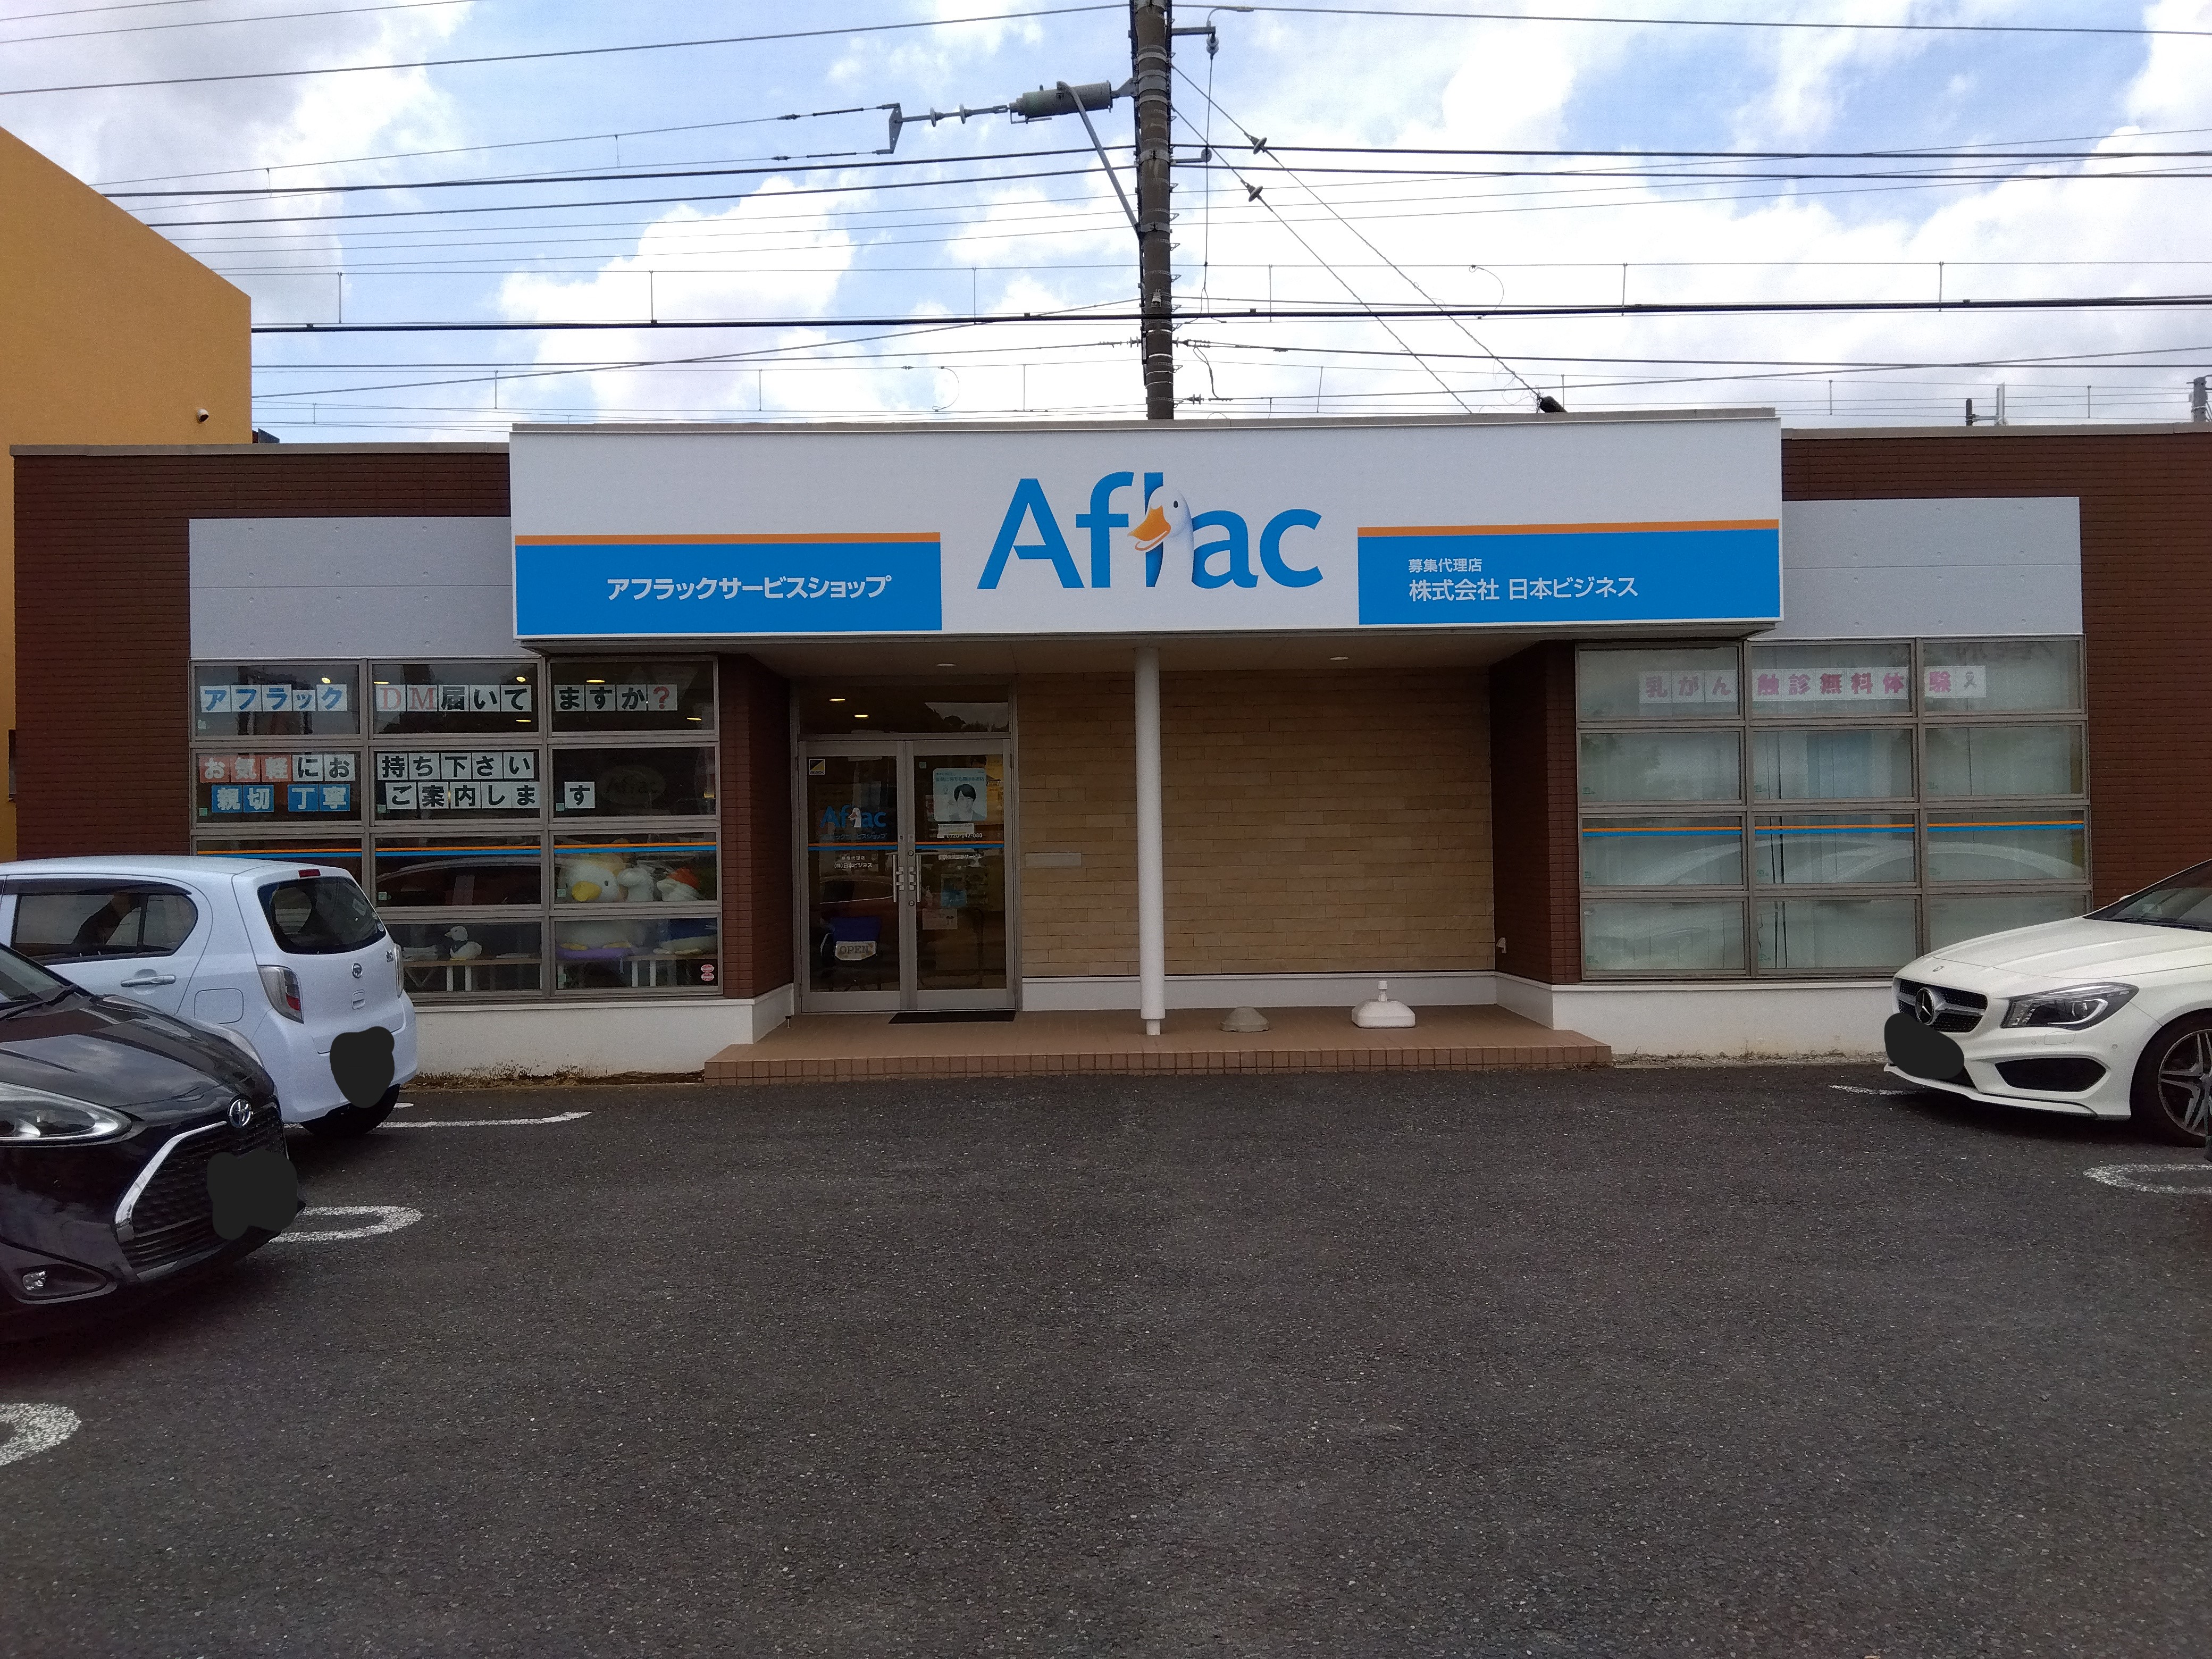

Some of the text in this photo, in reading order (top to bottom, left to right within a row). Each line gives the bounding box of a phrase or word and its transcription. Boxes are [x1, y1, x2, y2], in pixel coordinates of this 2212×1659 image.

[976, 471, 1324, 589] Aflac
[1408, 557, 1482, 574] 募集代理店
[607, 574, 892, 600] アフラックサービスショップ
[1408, 576, 1639, 602] 株式会社 日本ビジネス
[204, 685, 670, 711] アフラック DM届いて ますか?
[1645, 674, 1731, 699] 乳がん
[1757, 671, 1907, 696] 触診無料体
[204, 755, 531, 780] お気軽にお 持ち下さい
[216, 786, 271, 811] 親切
[391, 784, 537, 808] ご案内しま
[569, 784, 590, 805] す
[819, 805, 887, 828] Afac
[840, 945, 869, 954] OPEN
